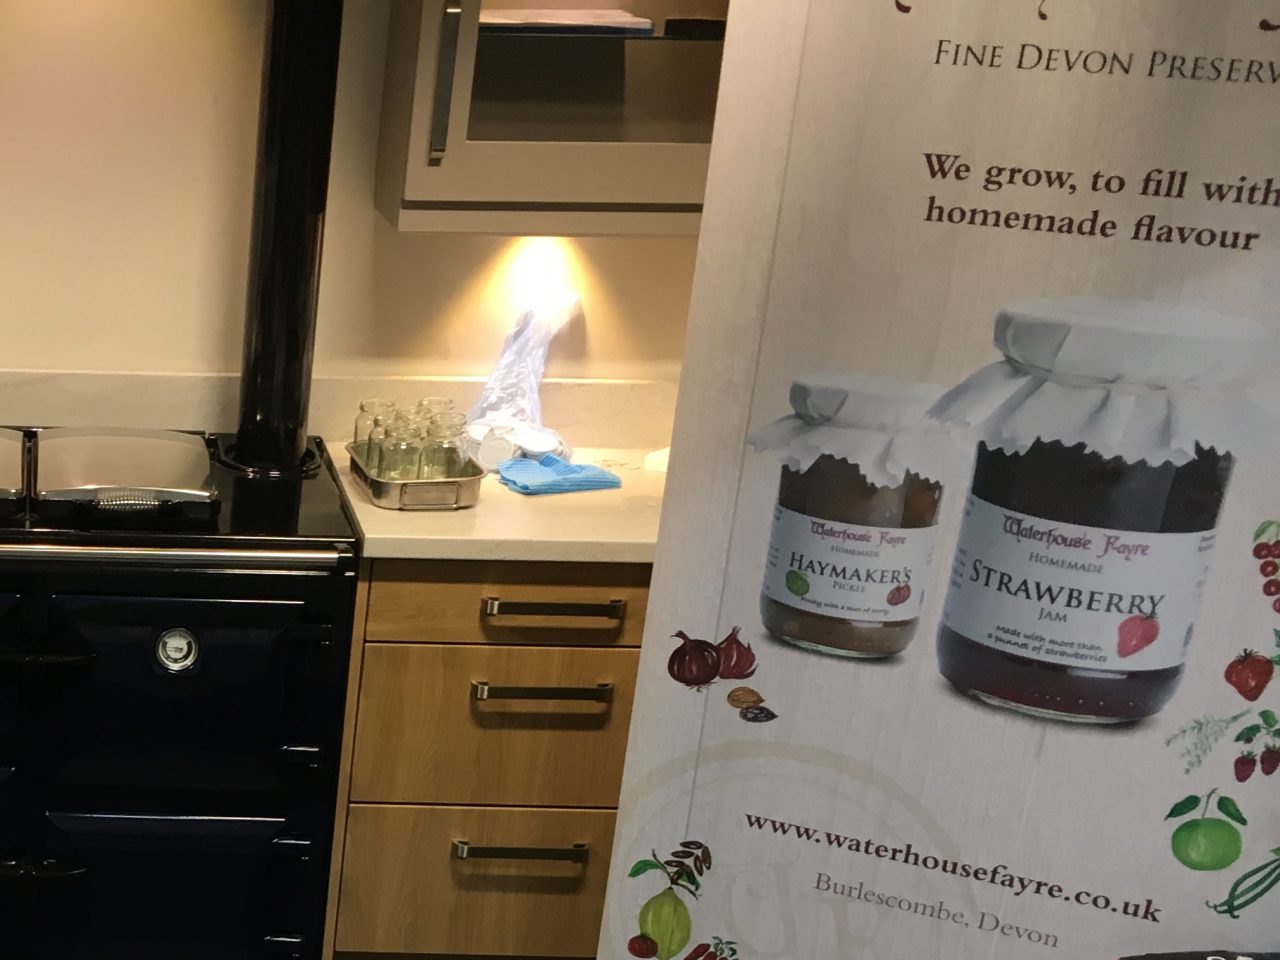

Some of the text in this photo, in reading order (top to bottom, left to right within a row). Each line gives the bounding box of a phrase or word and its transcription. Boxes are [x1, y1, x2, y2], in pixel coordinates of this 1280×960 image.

[1017, 43, 1135, 76] DEVON
[923, 152, 1280, 207] We grow, to fill with
[924, 196, 1261, 251] homemade flavour
[1003, 512, 1150, 562] Waterhouse Fayre
[790, 551, 912, 585] HAYMAKER'S
[969, 558, 1166, 619] STRAWBERRY
[745, 813, 1162, 924] www.waterhousefayre.co.uk
[815, 871, 1060, 949] Burlescombe, Devon
